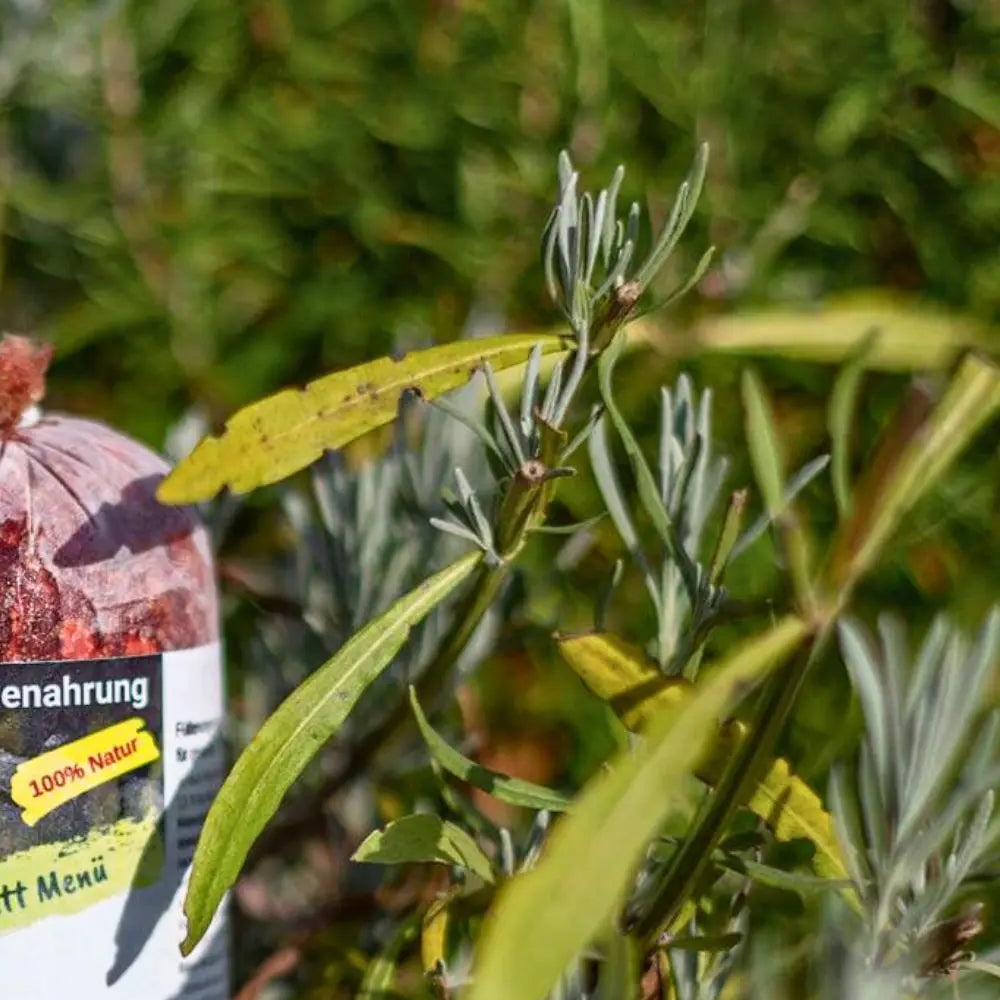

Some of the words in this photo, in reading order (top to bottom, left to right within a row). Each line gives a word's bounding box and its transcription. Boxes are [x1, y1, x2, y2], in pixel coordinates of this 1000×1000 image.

[28, 763, 85, 799] 100%
[88, 737, 139, 771] Natur
[36, 856, 109, 904] Menü
